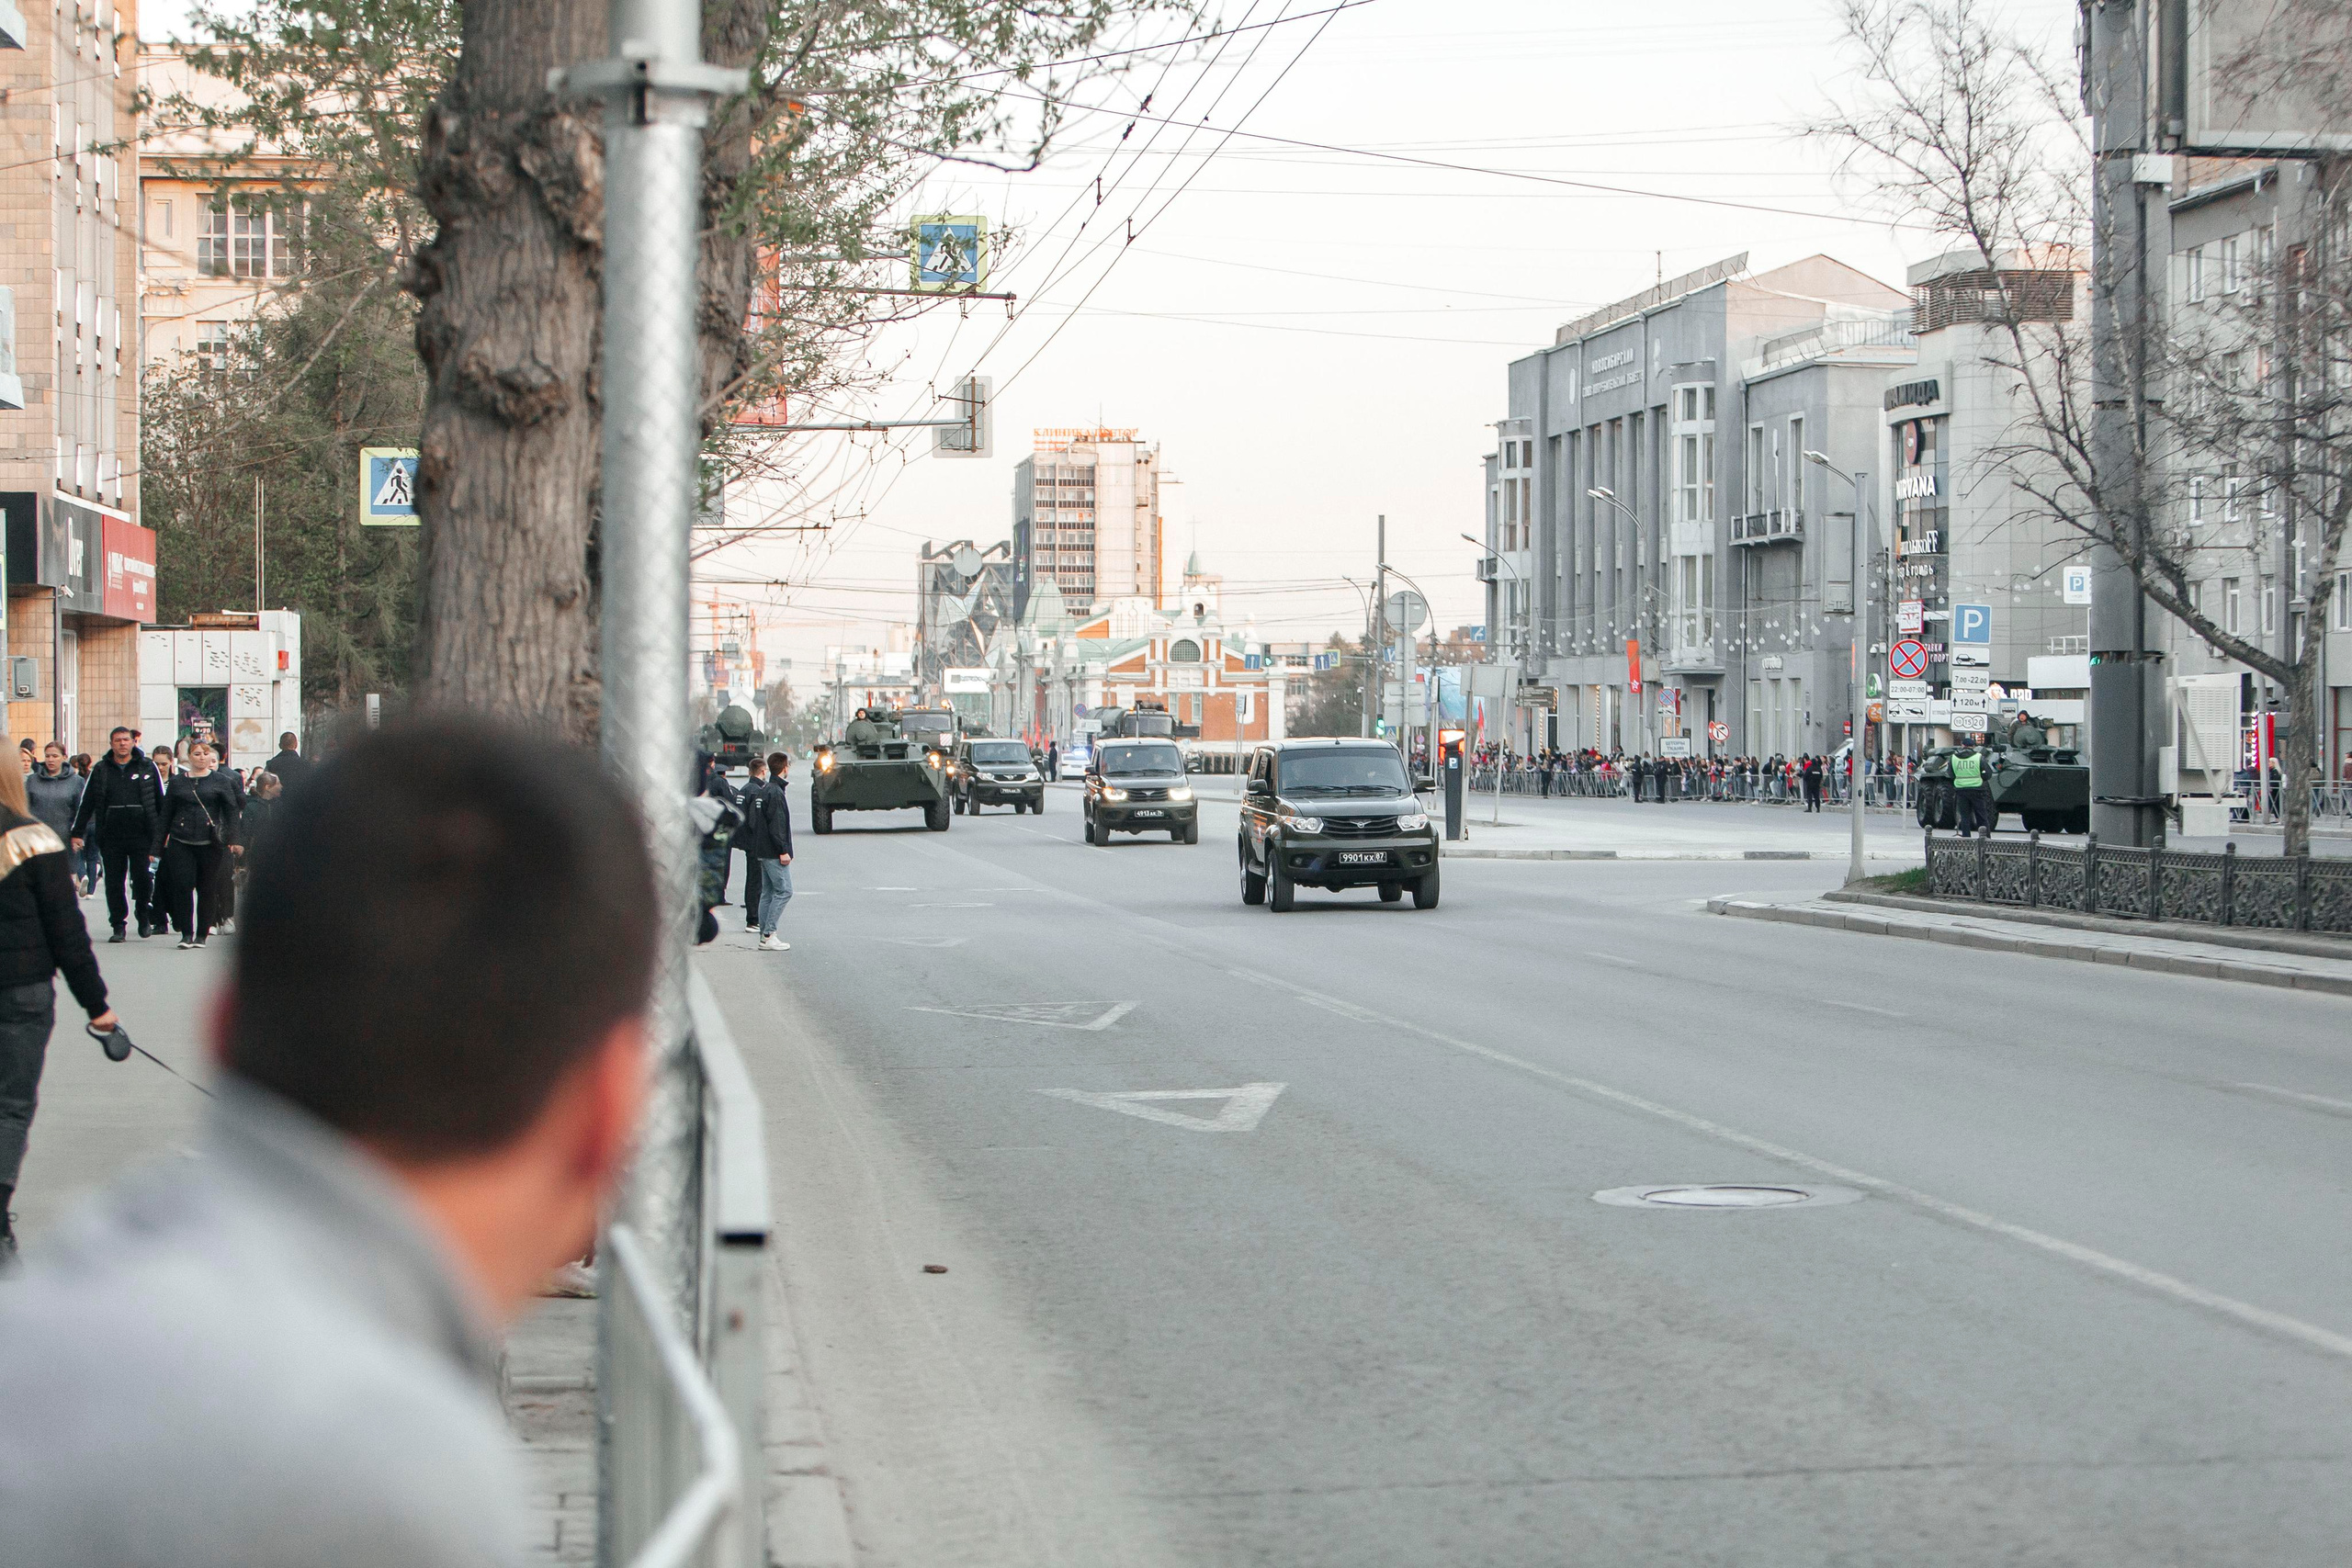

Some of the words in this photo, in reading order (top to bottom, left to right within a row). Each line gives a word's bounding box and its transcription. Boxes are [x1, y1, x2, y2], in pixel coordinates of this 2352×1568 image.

[1896, 476, 1936, 501] NIRVANA
[2073, 577, 2083, 591] P
[1963, 609, 1983, 638] P
[1929, 653, 1949, 663] СПОРТ
[1449, 757, 1457, 768] P
[1956, 760, 1975, 771] ДПС
[1375, 852, 1385, 862] 87
